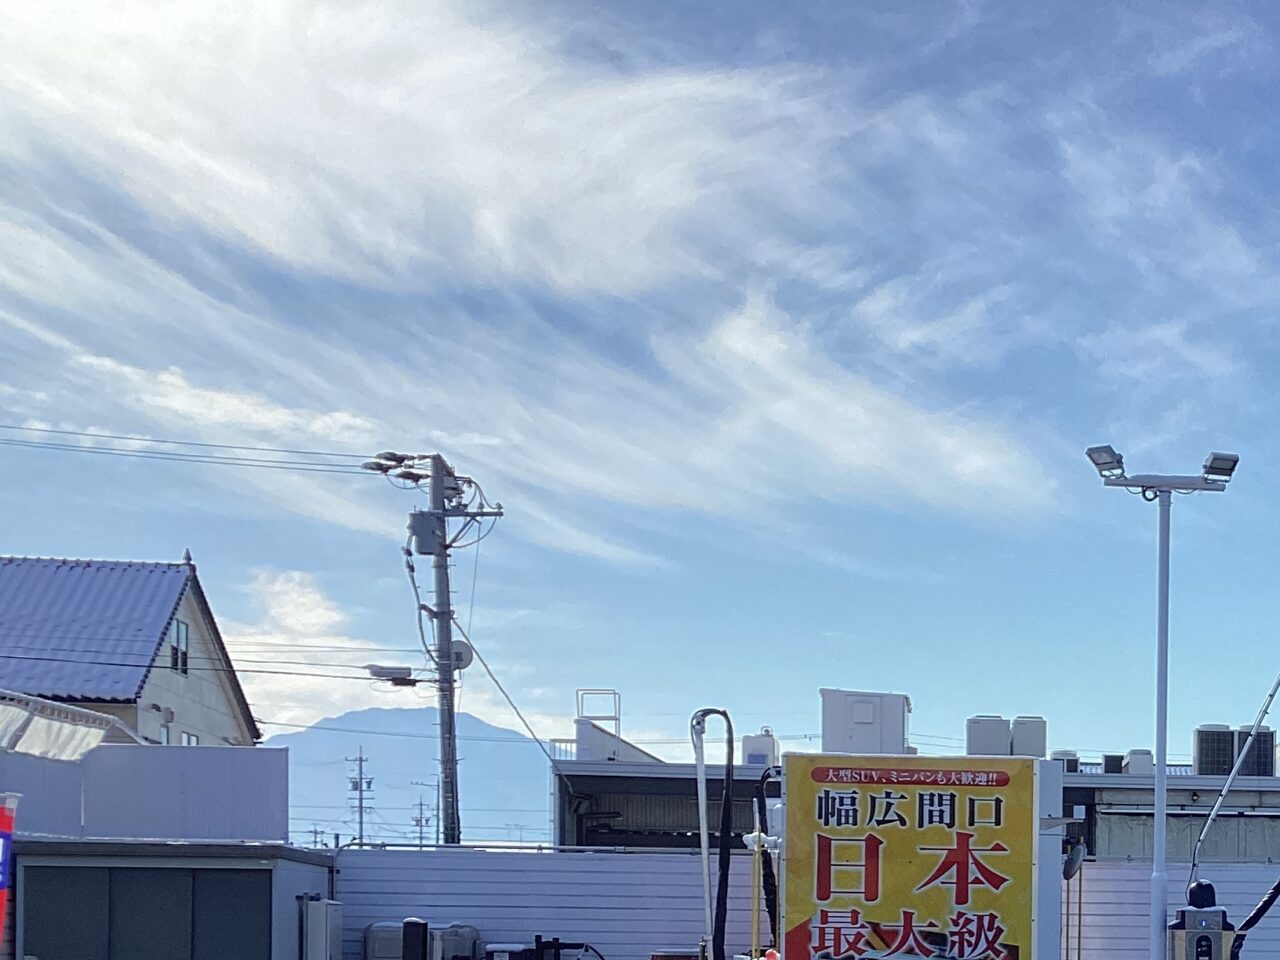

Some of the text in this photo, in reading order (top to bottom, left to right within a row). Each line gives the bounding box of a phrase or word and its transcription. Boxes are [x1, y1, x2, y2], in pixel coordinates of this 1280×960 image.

[825, 769, 997, 786] 大型SUV、ミニバンも大歓迎!!
[817, 790, 1004, 829] 幅広間口
[816, 832, 1010, 905] 日本
[811, 909, 1008, 959] 最大級
